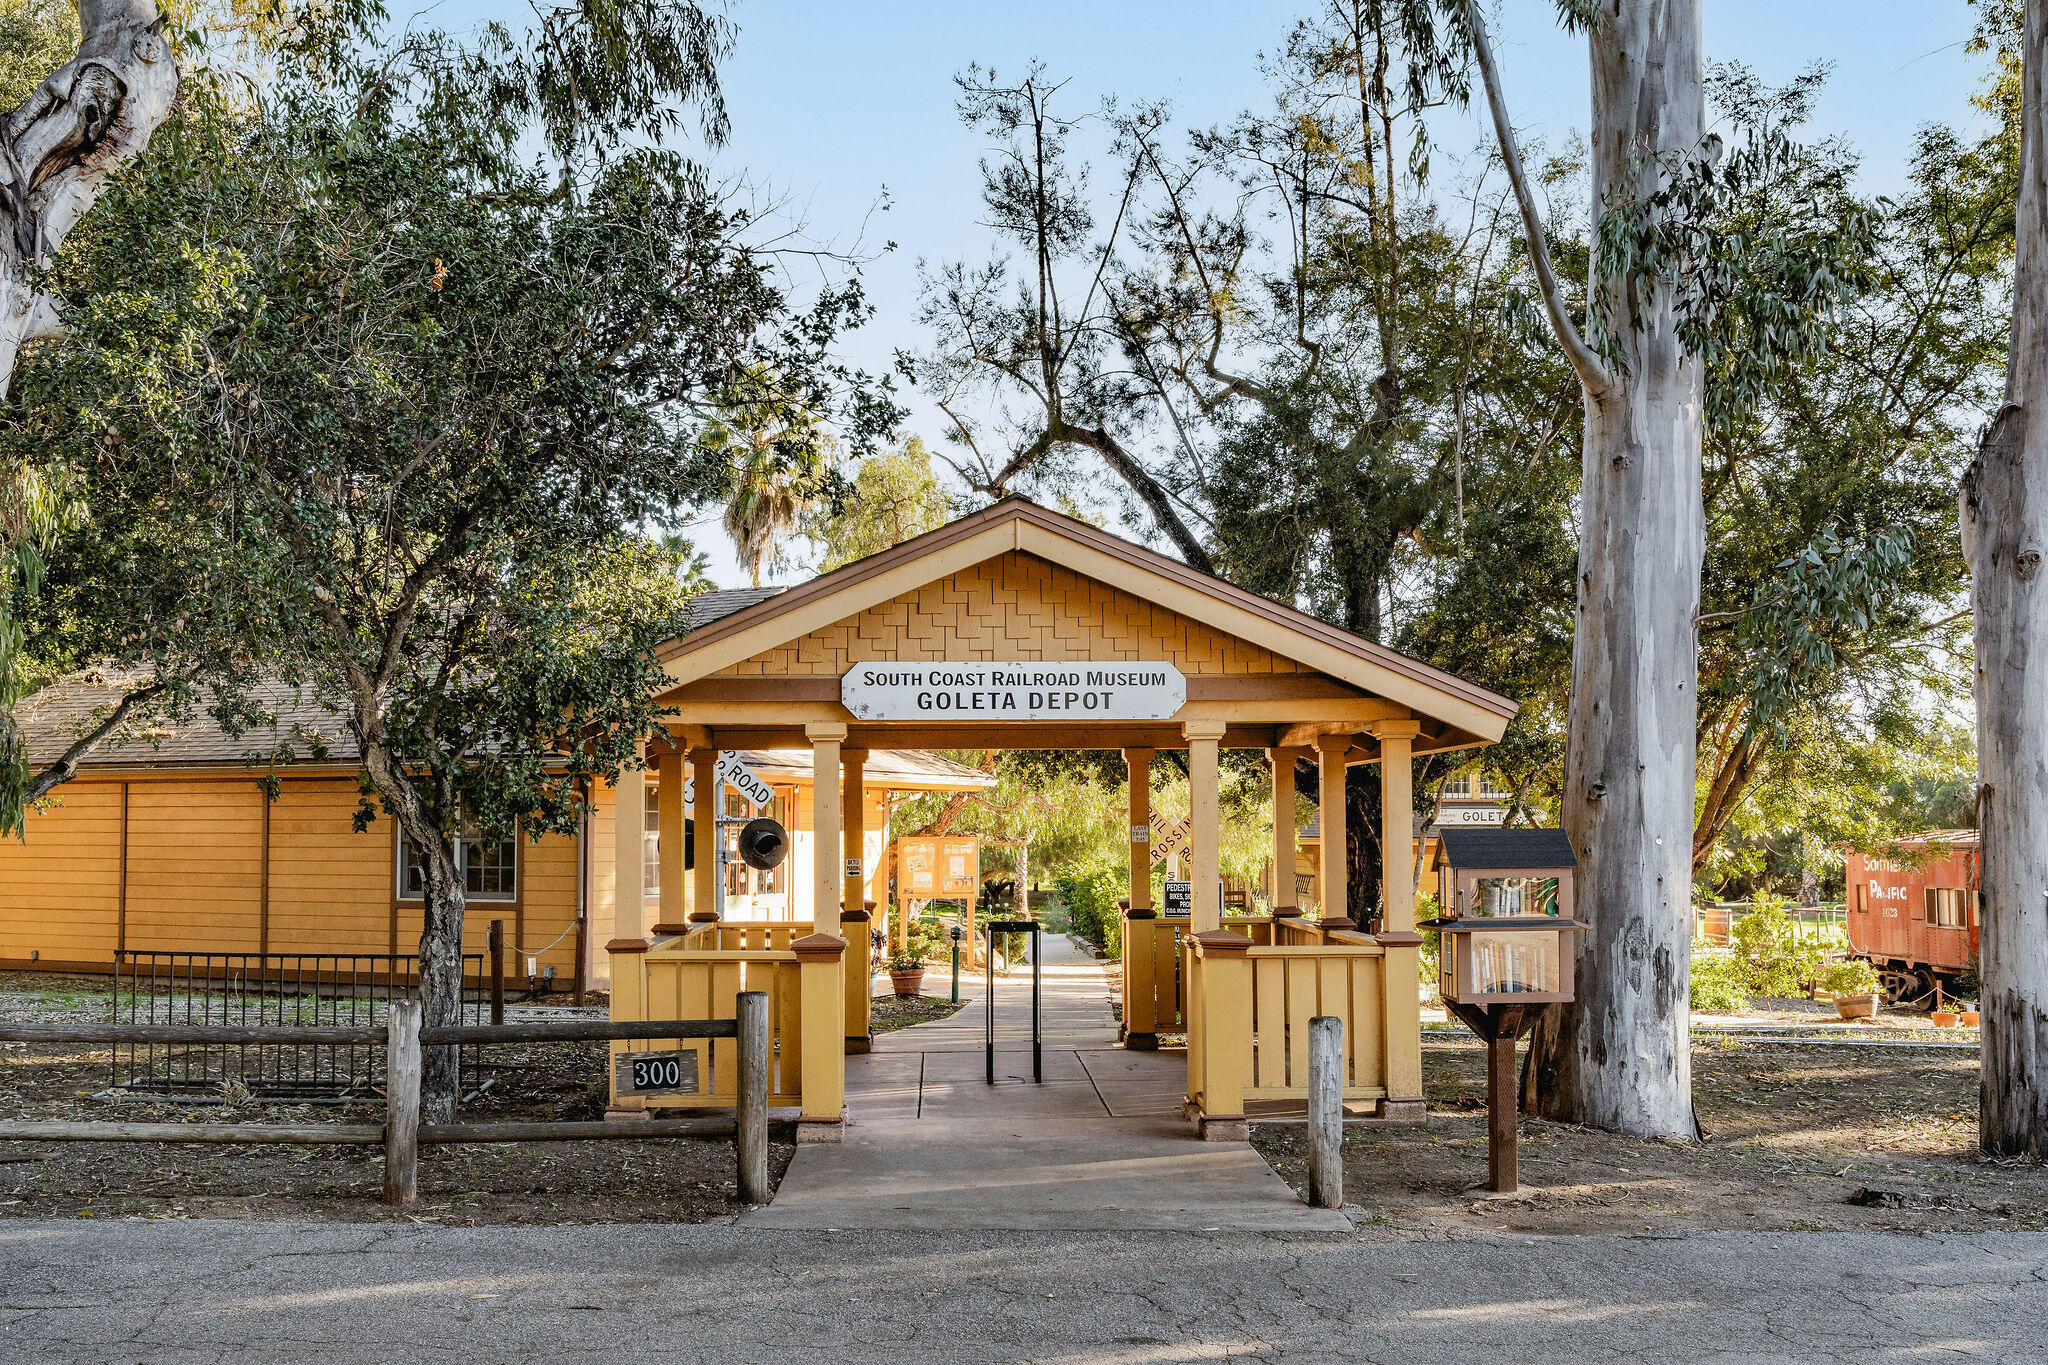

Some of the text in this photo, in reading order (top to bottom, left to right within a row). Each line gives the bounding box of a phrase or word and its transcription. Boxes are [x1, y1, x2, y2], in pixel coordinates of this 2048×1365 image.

[917, 692, 1114, 710] GOLETA DEPOT
[727, 765, 769, 803] ROAD
[1462, 811, 1505, 822] GOLET
[1869, 879, 1908, 900] PACIFIC
[635, 1061, 680, 1086] 300
